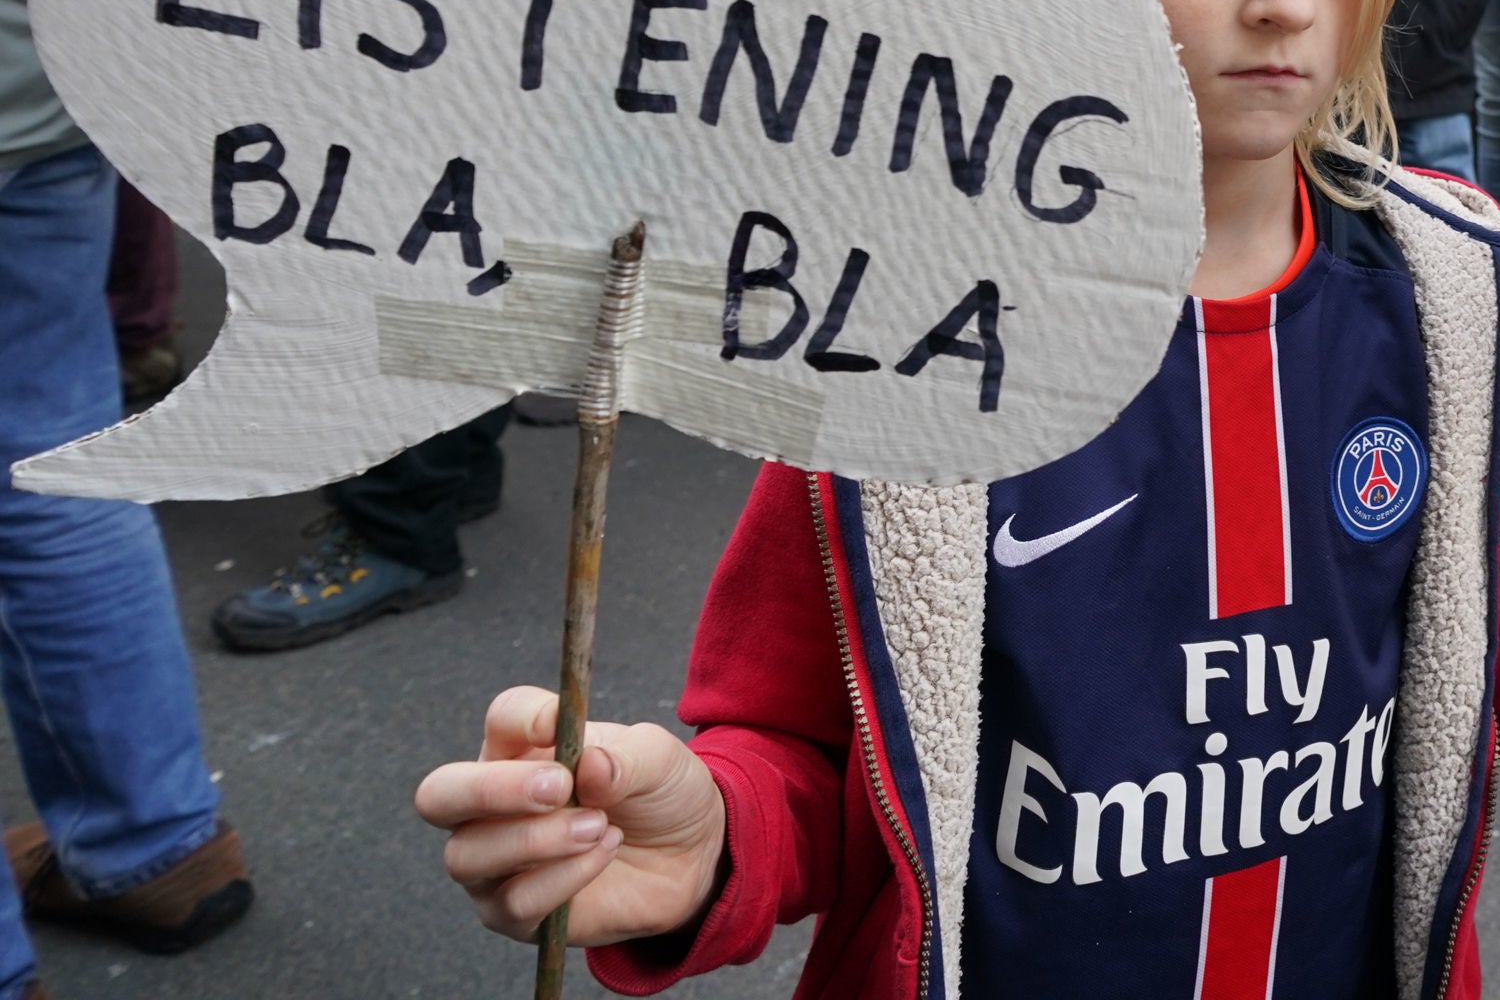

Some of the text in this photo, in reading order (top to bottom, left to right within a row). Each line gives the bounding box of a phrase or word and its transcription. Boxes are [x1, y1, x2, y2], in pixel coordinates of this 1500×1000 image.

[211, 122, 1016, 412] BLA, BLA
[1348, 431, 1405, 460] PARIS
[1179, 633, 1331, 725] Fly
